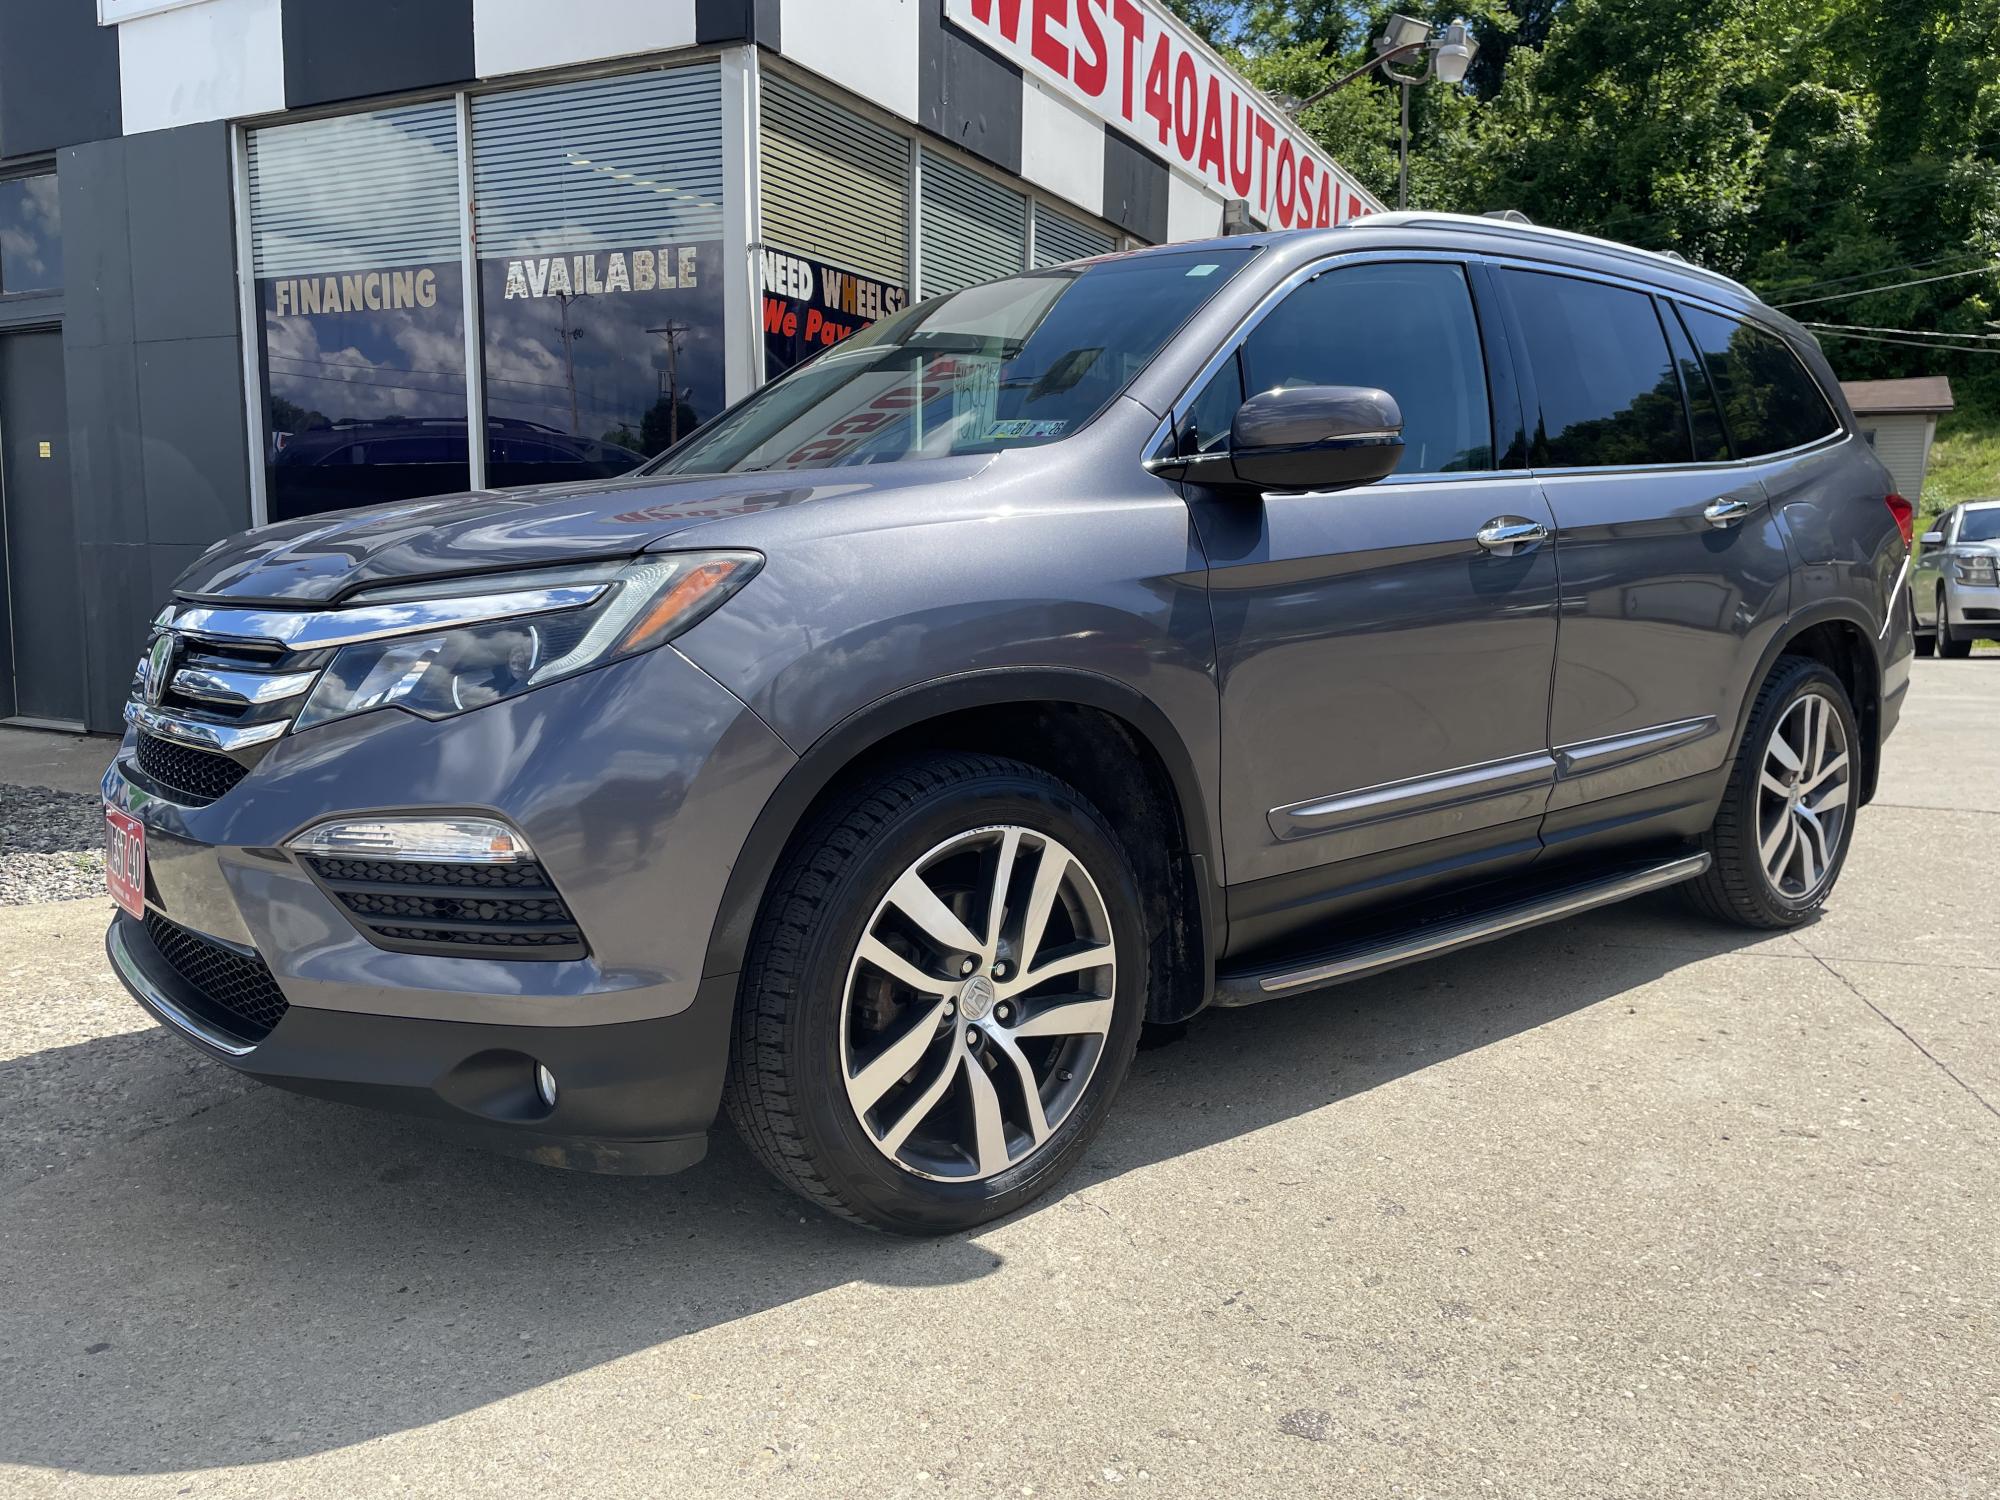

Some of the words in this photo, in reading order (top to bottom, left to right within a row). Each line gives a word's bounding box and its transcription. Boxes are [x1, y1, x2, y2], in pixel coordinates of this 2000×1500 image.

[275, 268, 437, 318] FINANCING
[504, 246, 698, 300] AVAILABLE
[761, 249, 814, 302] NEED
[762, 297, 797, 338] We
[128, 834, 142, 892] 40
